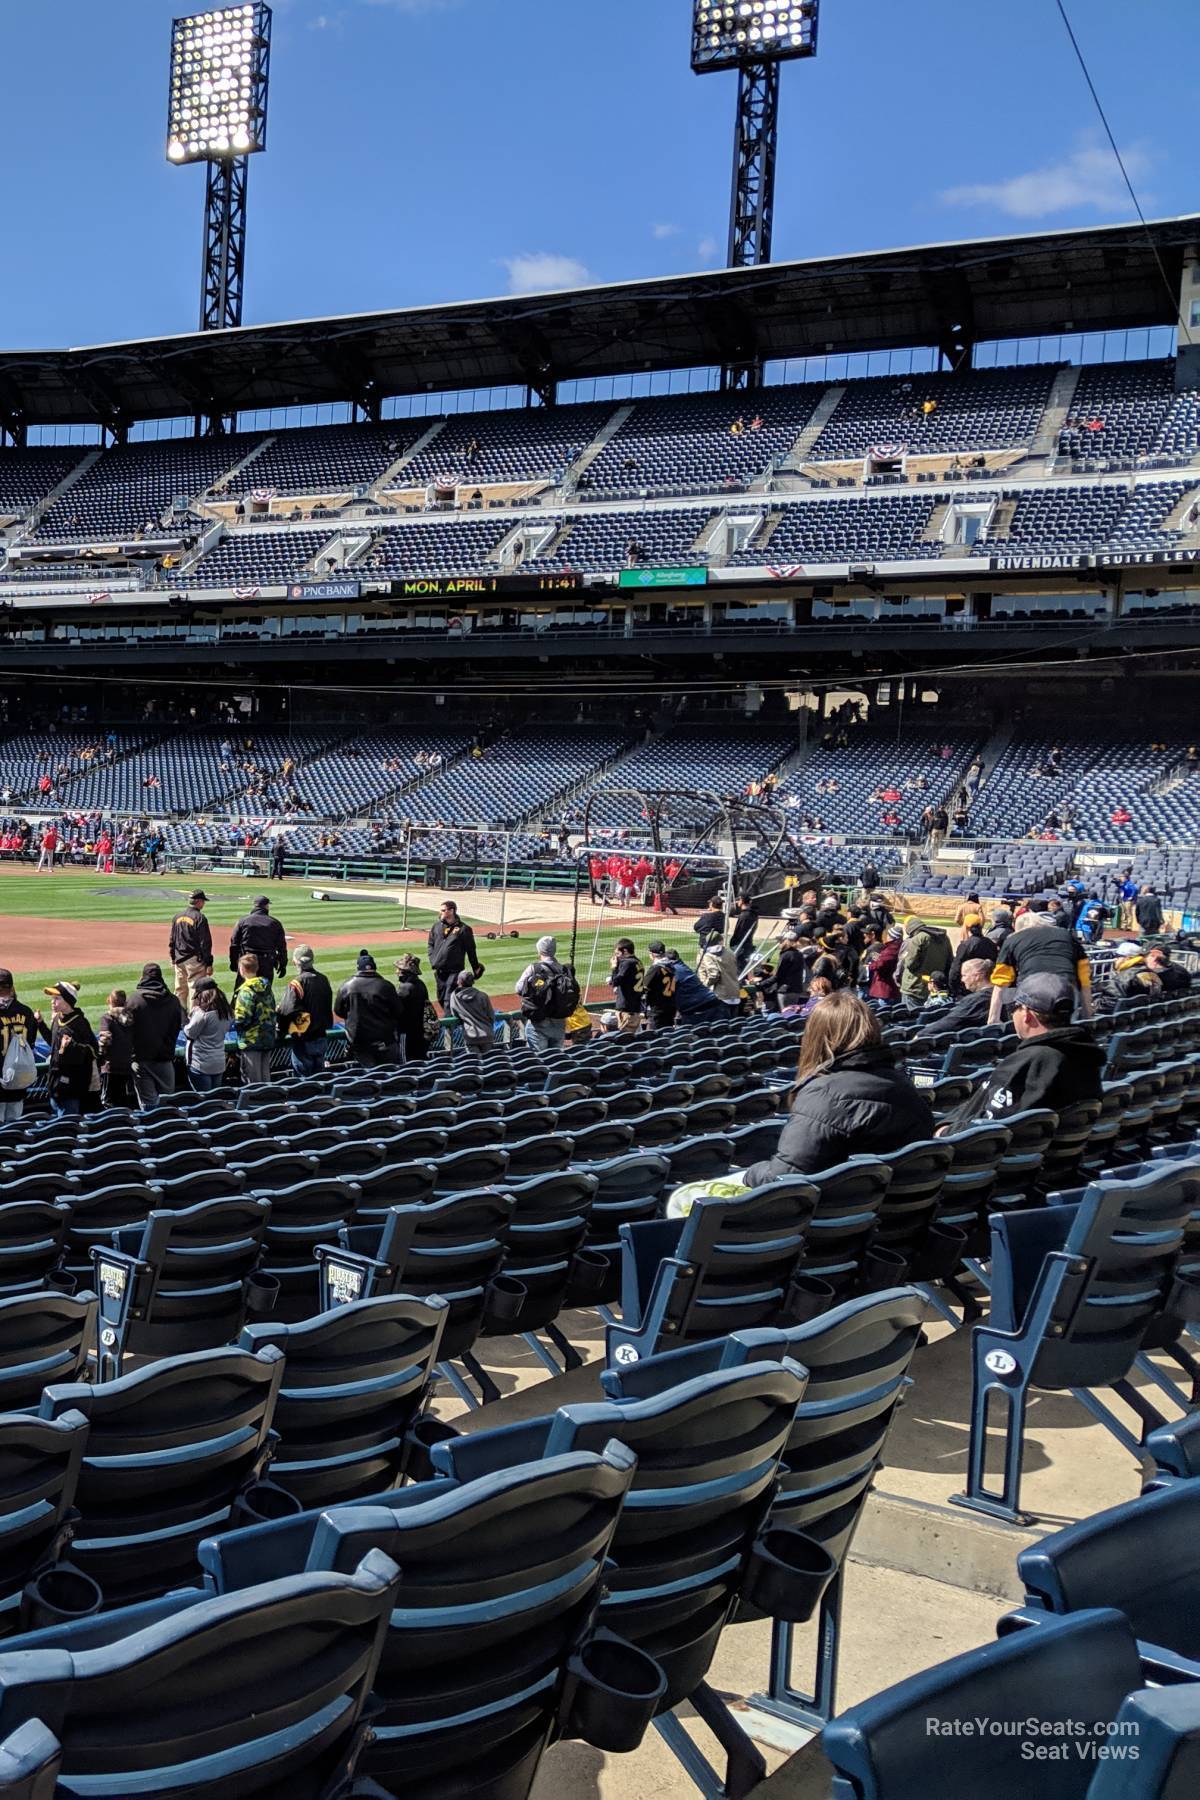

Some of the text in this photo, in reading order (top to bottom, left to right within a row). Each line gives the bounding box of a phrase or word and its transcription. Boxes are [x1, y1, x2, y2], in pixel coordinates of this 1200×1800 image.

[997, 556, 1080, 570] RIVENDALE
[1102, 553, 1154, 565] SUITE
[404, 579, 497, 594] MON, APRIL 1
[539, 577, 576, 589] 11:41
[303, 584, 354, 596] PNC BANK
[104, 1331, 112, 1342] H
[620, 1348, 633, 1362] K
[994, 1354, 1006, 1370] L
